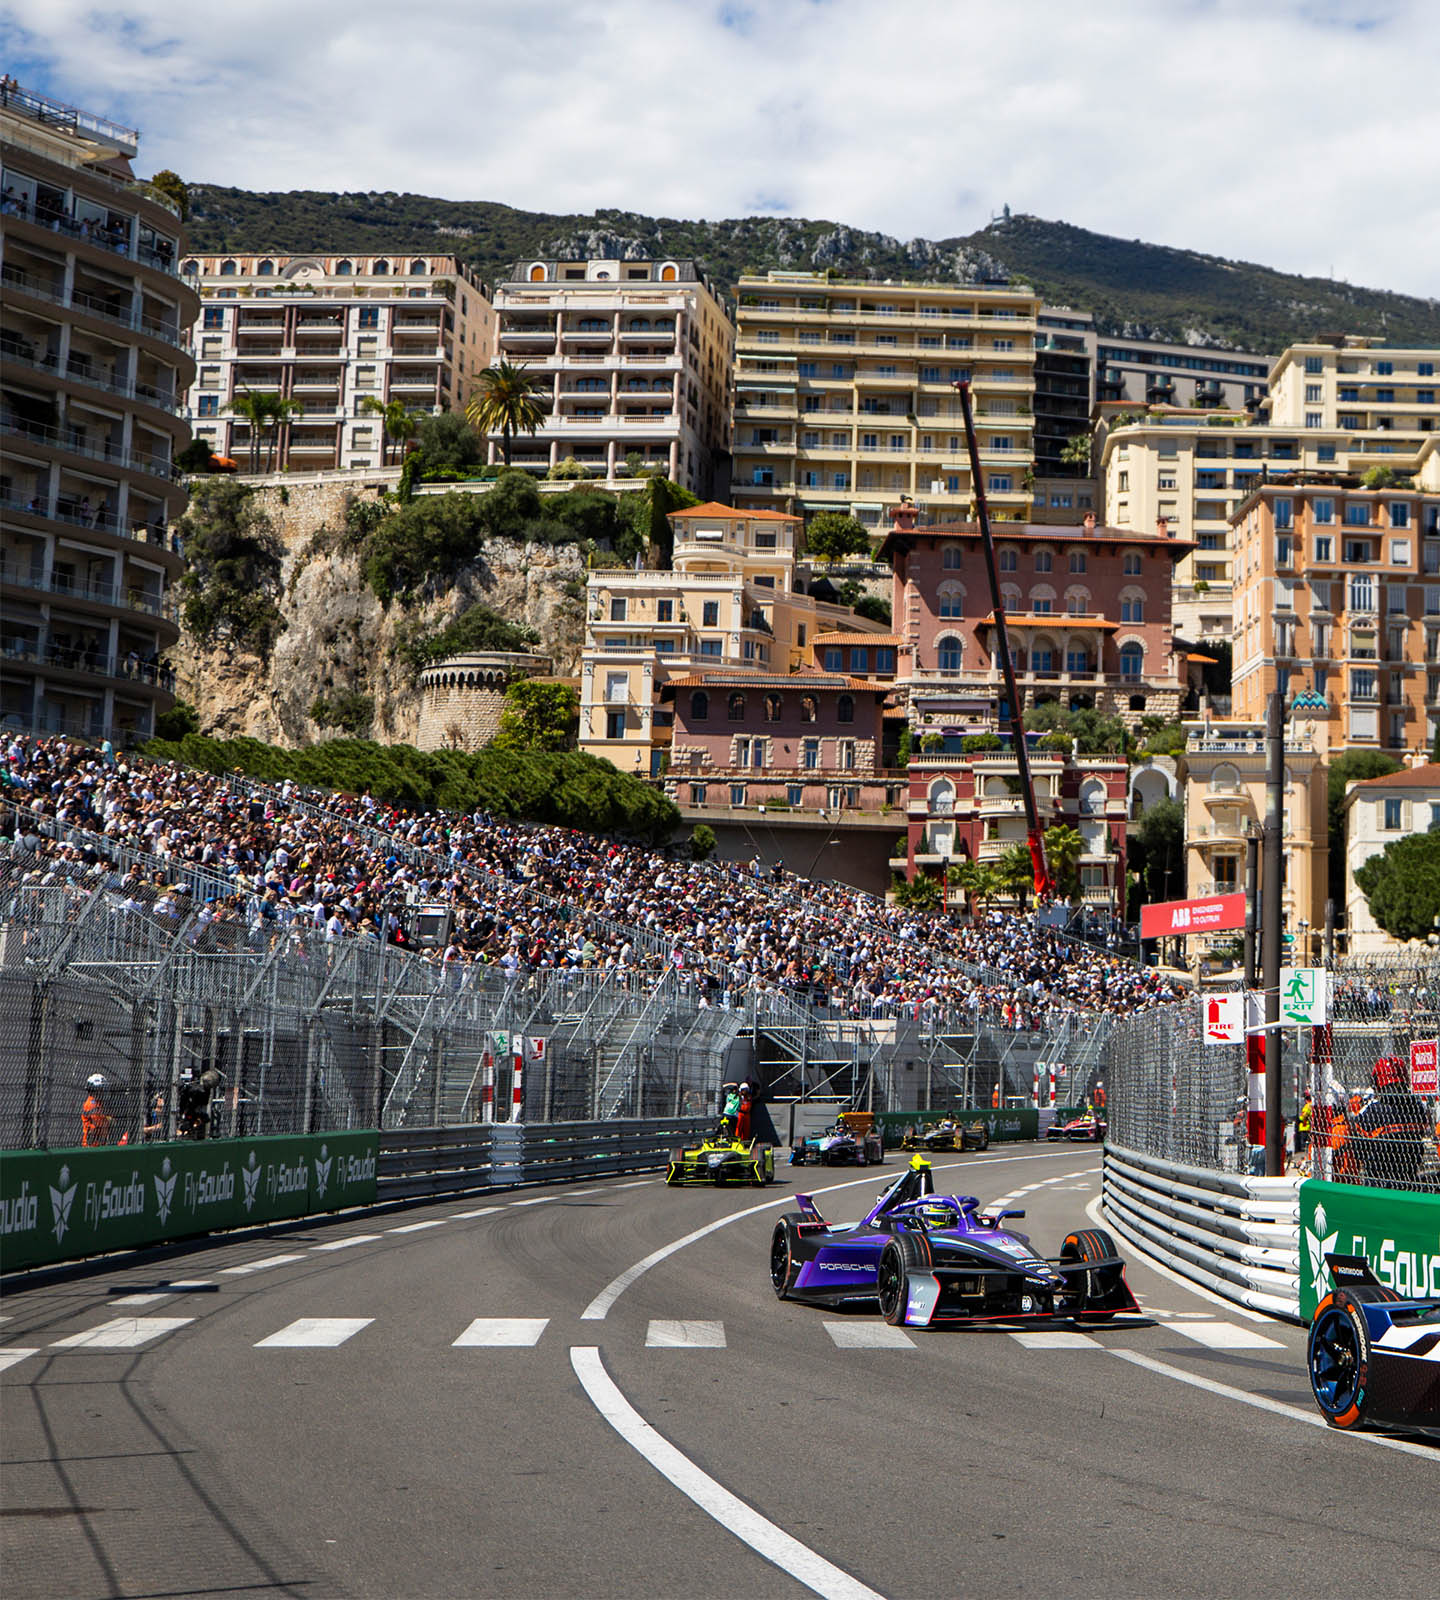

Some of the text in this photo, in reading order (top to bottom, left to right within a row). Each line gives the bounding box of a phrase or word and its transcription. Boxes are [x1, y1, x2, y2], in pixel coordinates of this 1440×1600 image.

[1171, 907, 1190, 928] ABB
[84, 1170, 145, 1231] FlySaudia
[819, 1263, 876, 1272] PORSCHE
